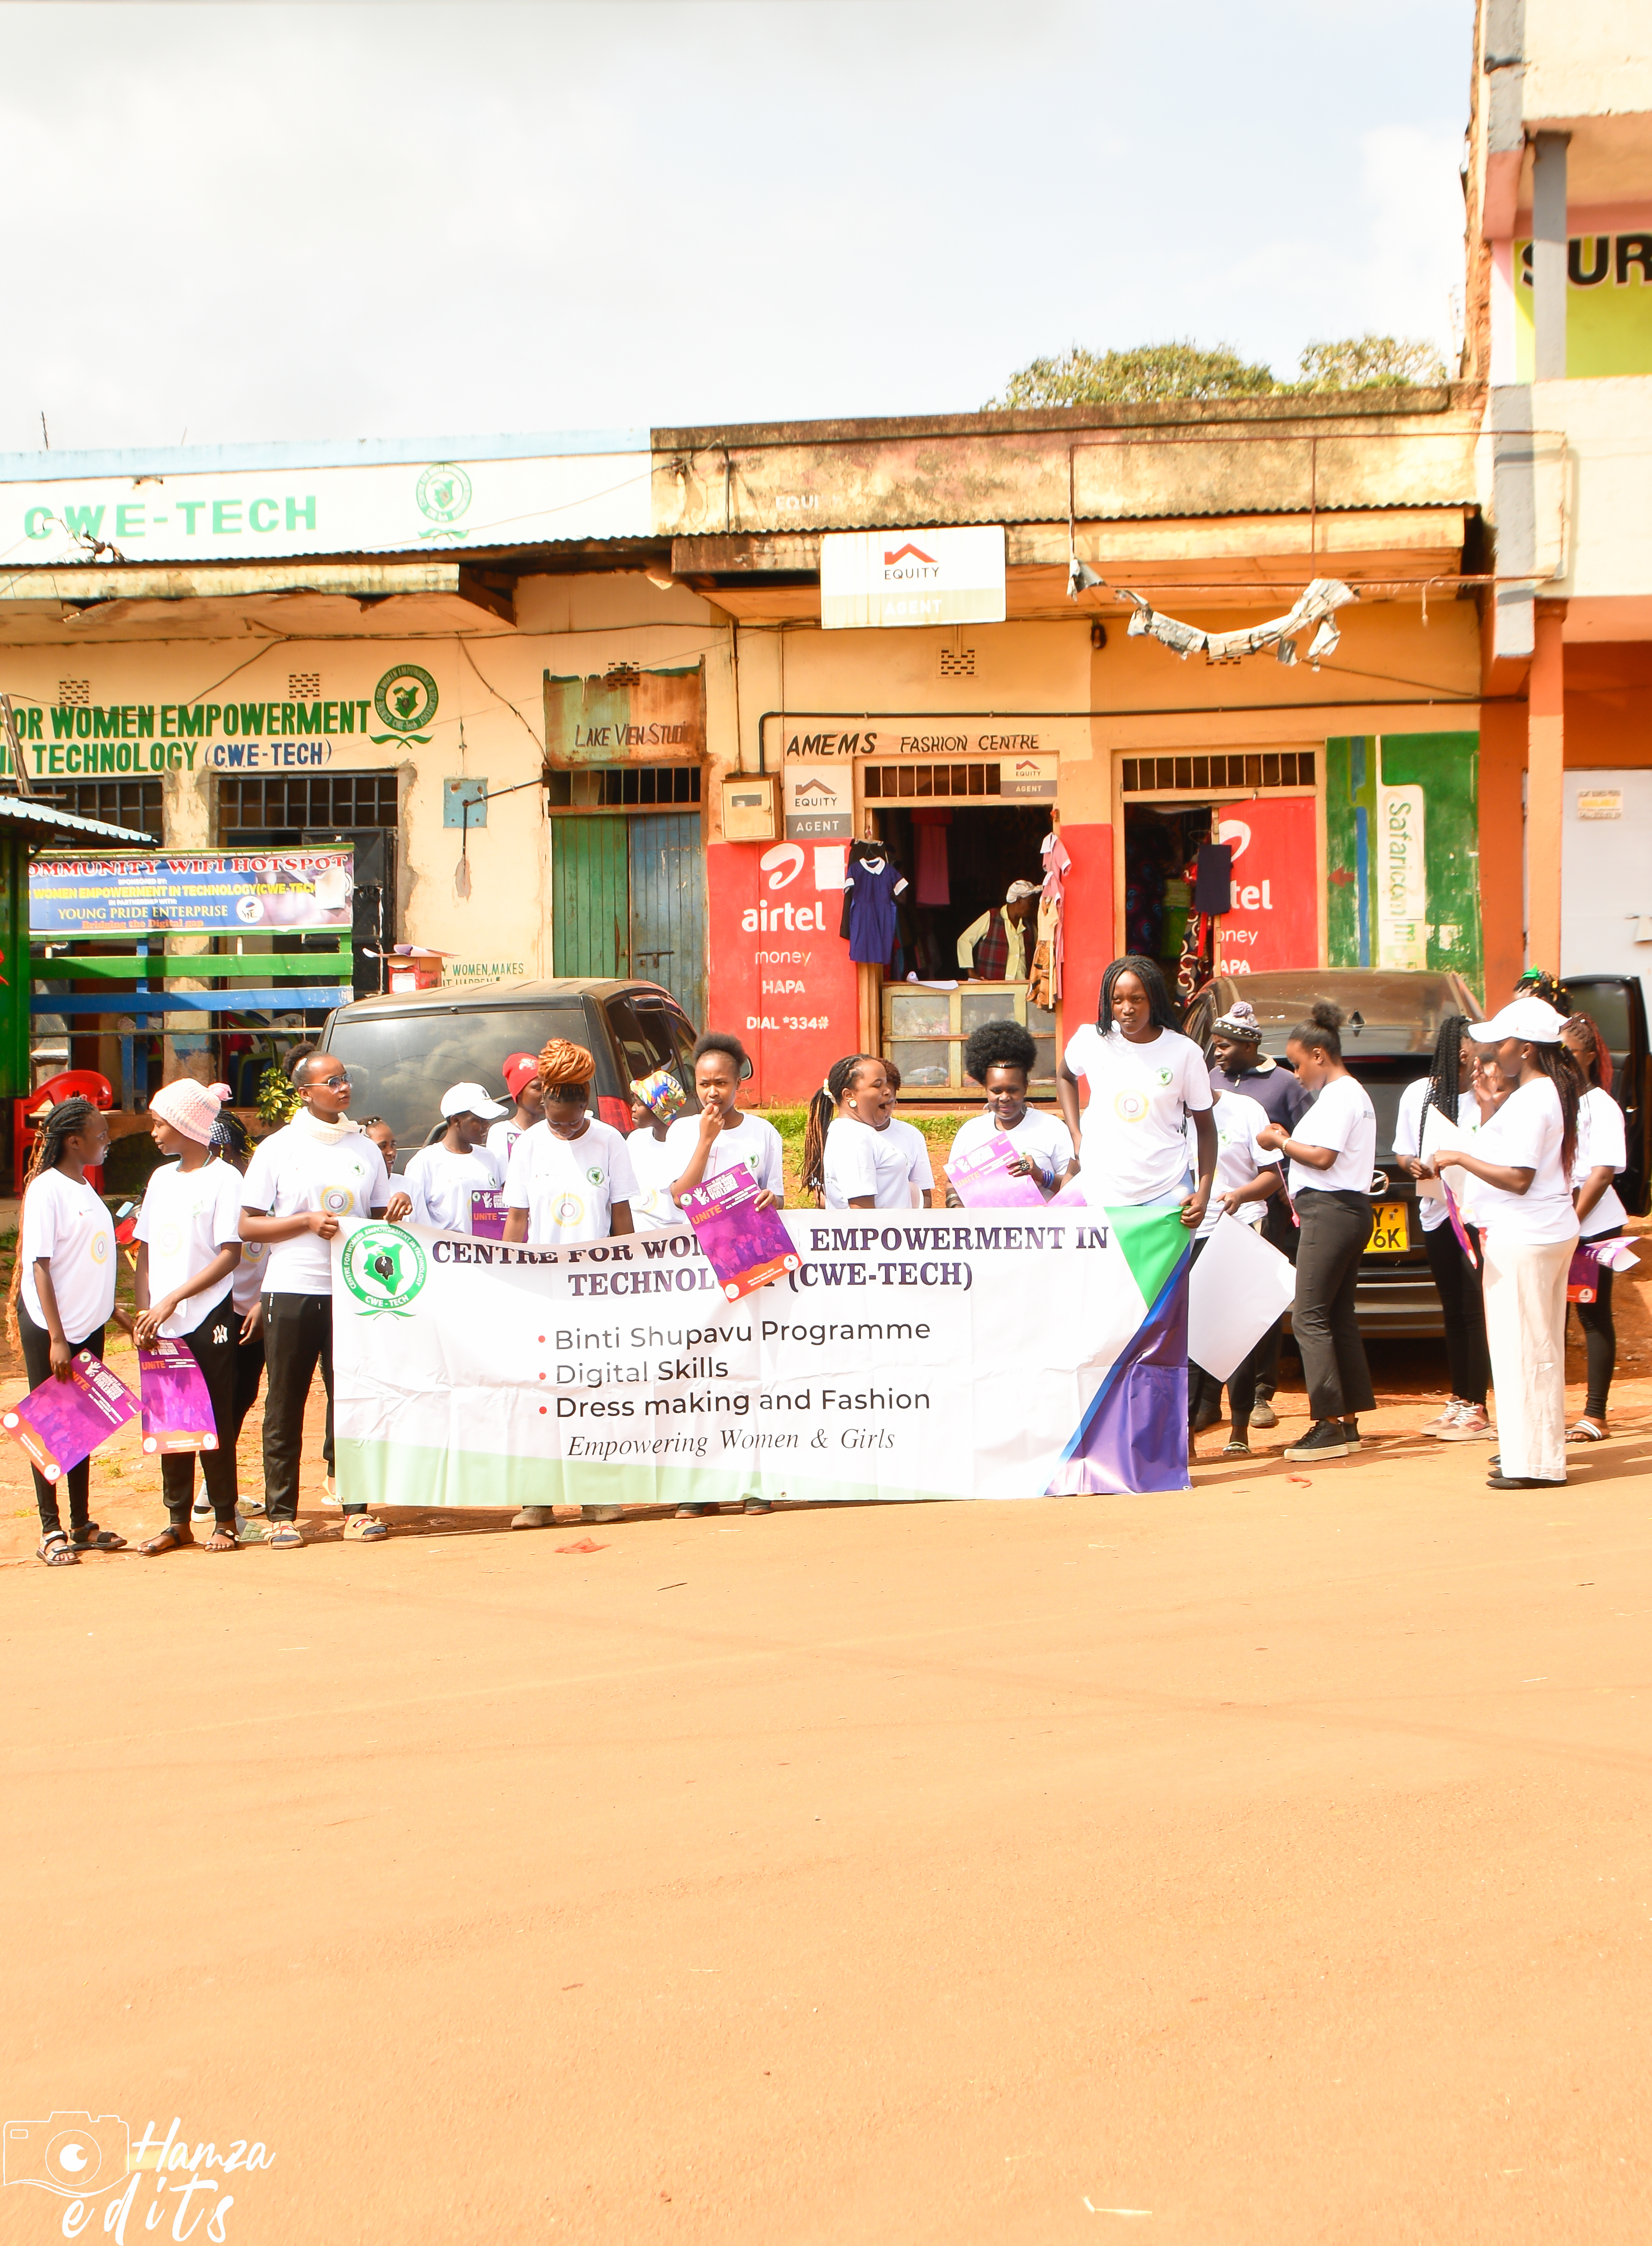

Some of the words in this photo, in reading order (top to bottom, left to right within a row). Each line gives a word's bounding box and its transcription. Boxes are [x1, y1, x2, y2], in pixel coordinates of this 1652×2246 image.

[24, 495, 316, 540] CWE-TECH
[885, 567, 940, 580] EQUITY
[885, 599, 942, 615] AGENT
[50, 705, 154, 739] WOMEN
[161, 700, 371, 738] EMPOWERMENT
[575, 724, 611, 747] LAKE
[786, 733, 877, 757] AMEMS
[900, 735, 968, 753] FASHION
[978, 734, 1040, 750] CENTRE
[32, 741, 198, 774] TECHNOLOGY
[795, 797, 837, 807] EQUITY
[796, 820, 839, 832] AGENT
[167, 859, 226, 874] WIFI
[231, 855, 348, 873] HOTSPOT
[33, 887, 78, 899] WOMEN
[78, 885, 167, 898] EMPOWERMENT
[168, 885, 182, 897] IN
[58, 908, 106, 920] YOUNG
[110, 907, 149, 919] PRIDE
[152, 905, 228, 918] ENTERPRISE
[741, 899, 826, 932] airtel
[755, 951, 812, 966] money
[762, 980, 806, 994] HAPA
[746, 1016, 780, 1030] DIAL
[708, 1182, 739, 1200] VIOLENCE
[347, 1231, 364, 1252] WOMEN
[365, 1226, 411, 1242] EMPOWERMENT
[433, 1239, 559, 1265] CENTRE
[568, 1244, 633, 1263] FOR
[810, 1226, 1065, 1252] EMPOWERMENT
[1075, 1226, 1109, 1250] IN
[344, 1266, 357, 1289] CENTRE
[413, 1246, 425, 1287] TECHNOLOGY
[789, 1261, 973, 1293] (CWE-TECH)
[556, 1327, 620, 1350] Binti
[631, 1326, 752, 1350] Shupavu
[762, 1320, 931, 1346] Programme
[557, 1361, 648, 1388] Digital
[657, 1357, 729, 1381] Skills
[557, 1398, 635, 1417] Dress
[645, 1390, 750, 1416] making
[759, 1388, 811, 1410] and
[822, 1387, 930, 1410] Fashion
[567, 1432, 709, 1461] Empowering
[720, 1429, 799, 1449] Women
[810, 1429, 829, 1449] &
[841, 1428, 895, 1449] Girls
